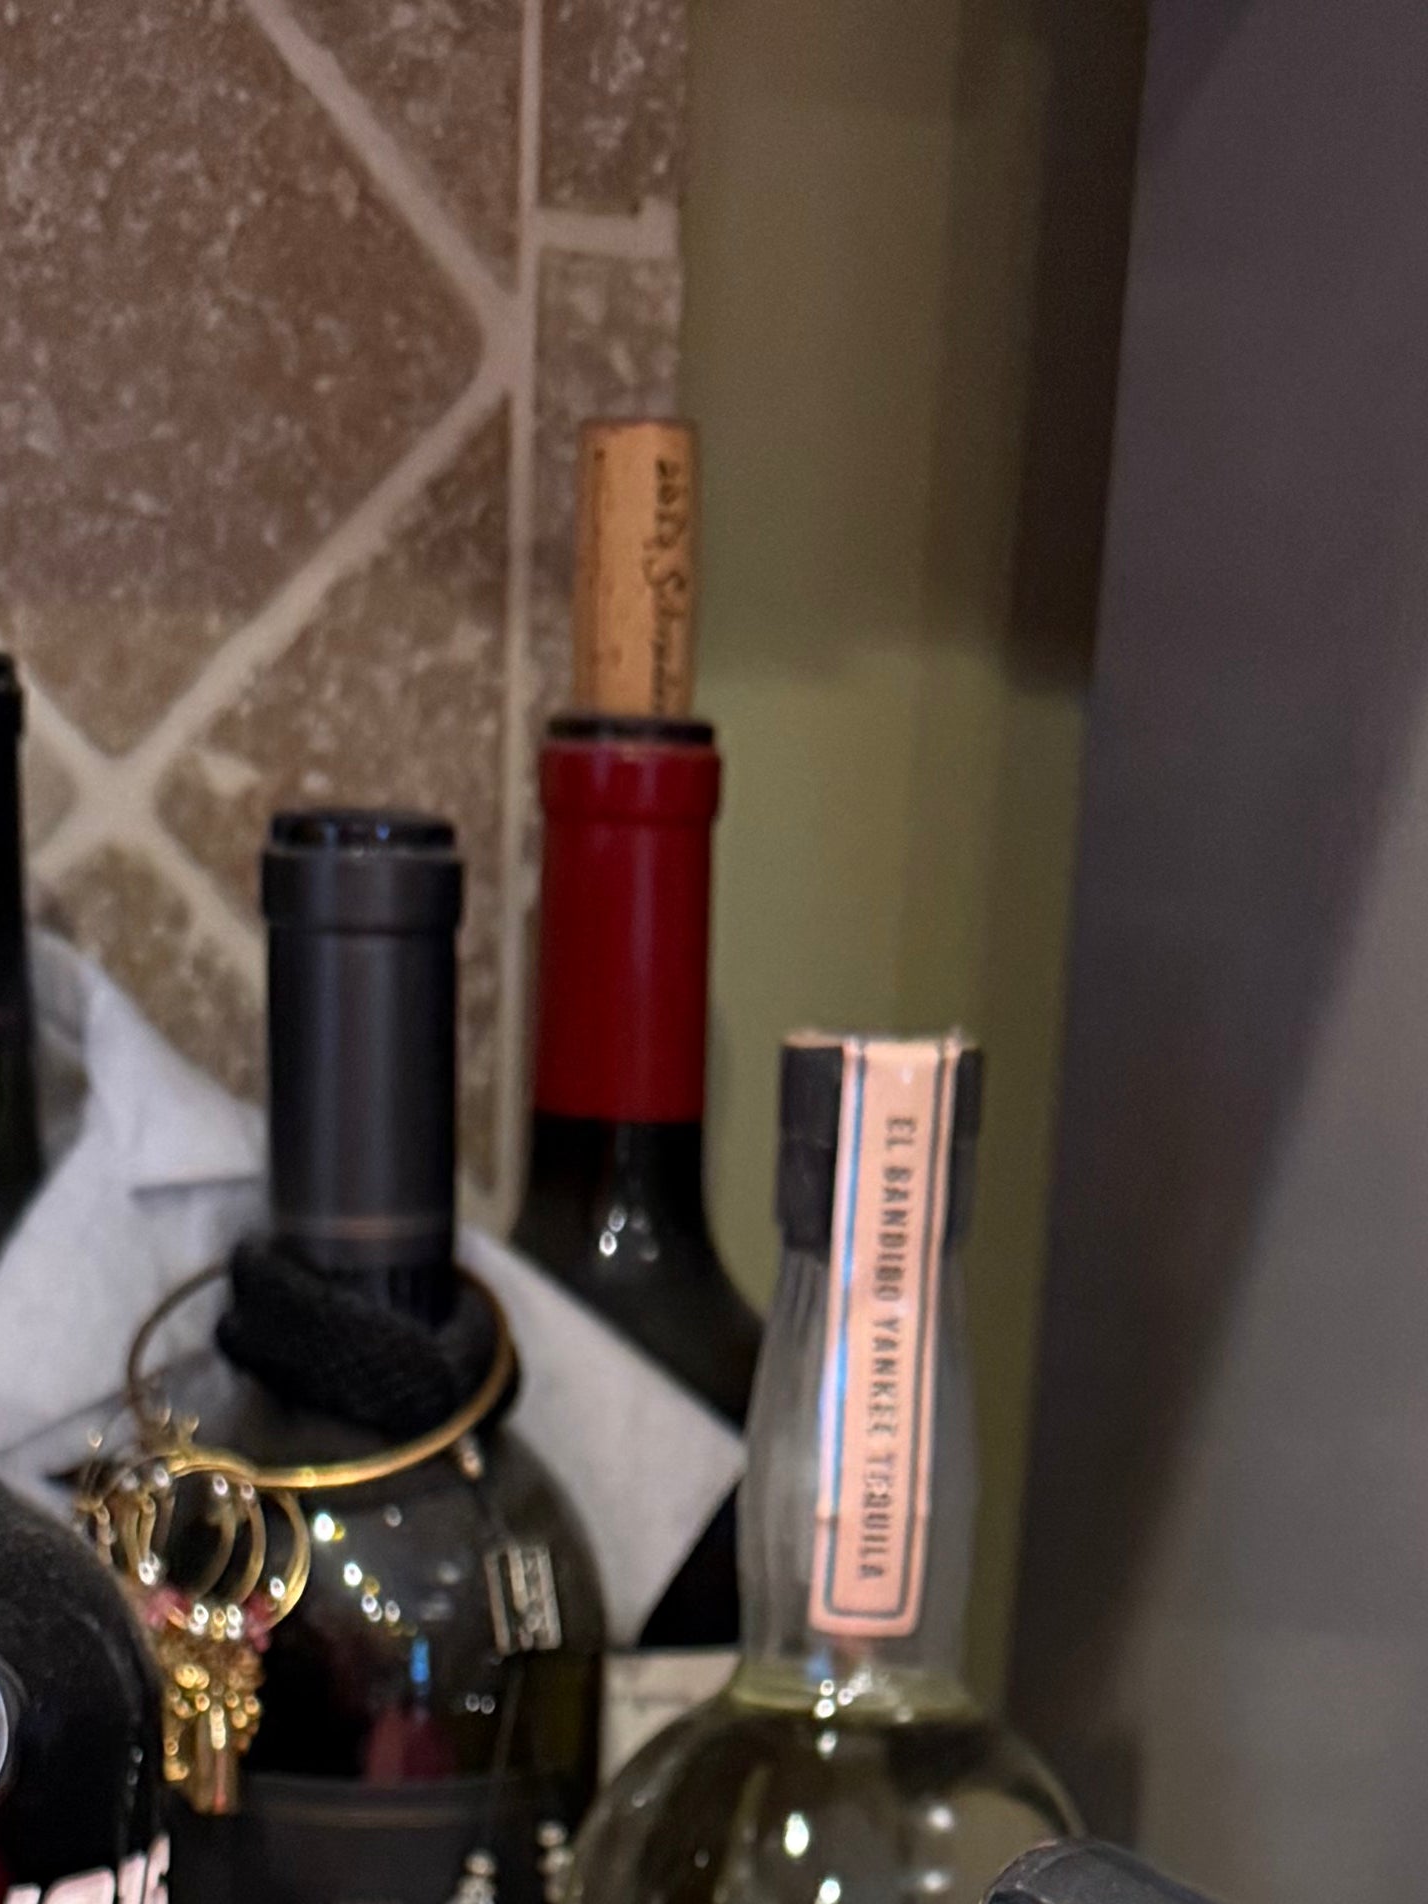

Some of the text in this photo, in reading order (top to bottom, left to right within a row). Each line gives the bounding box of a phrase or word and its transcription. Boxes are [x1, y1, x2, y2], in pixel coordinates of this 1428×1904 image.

[885, 1114, 918, 1152] EL
[867, 1316, 903, 1437] YANKEE
[857, 1453, 896, 1580] TEQUILA
